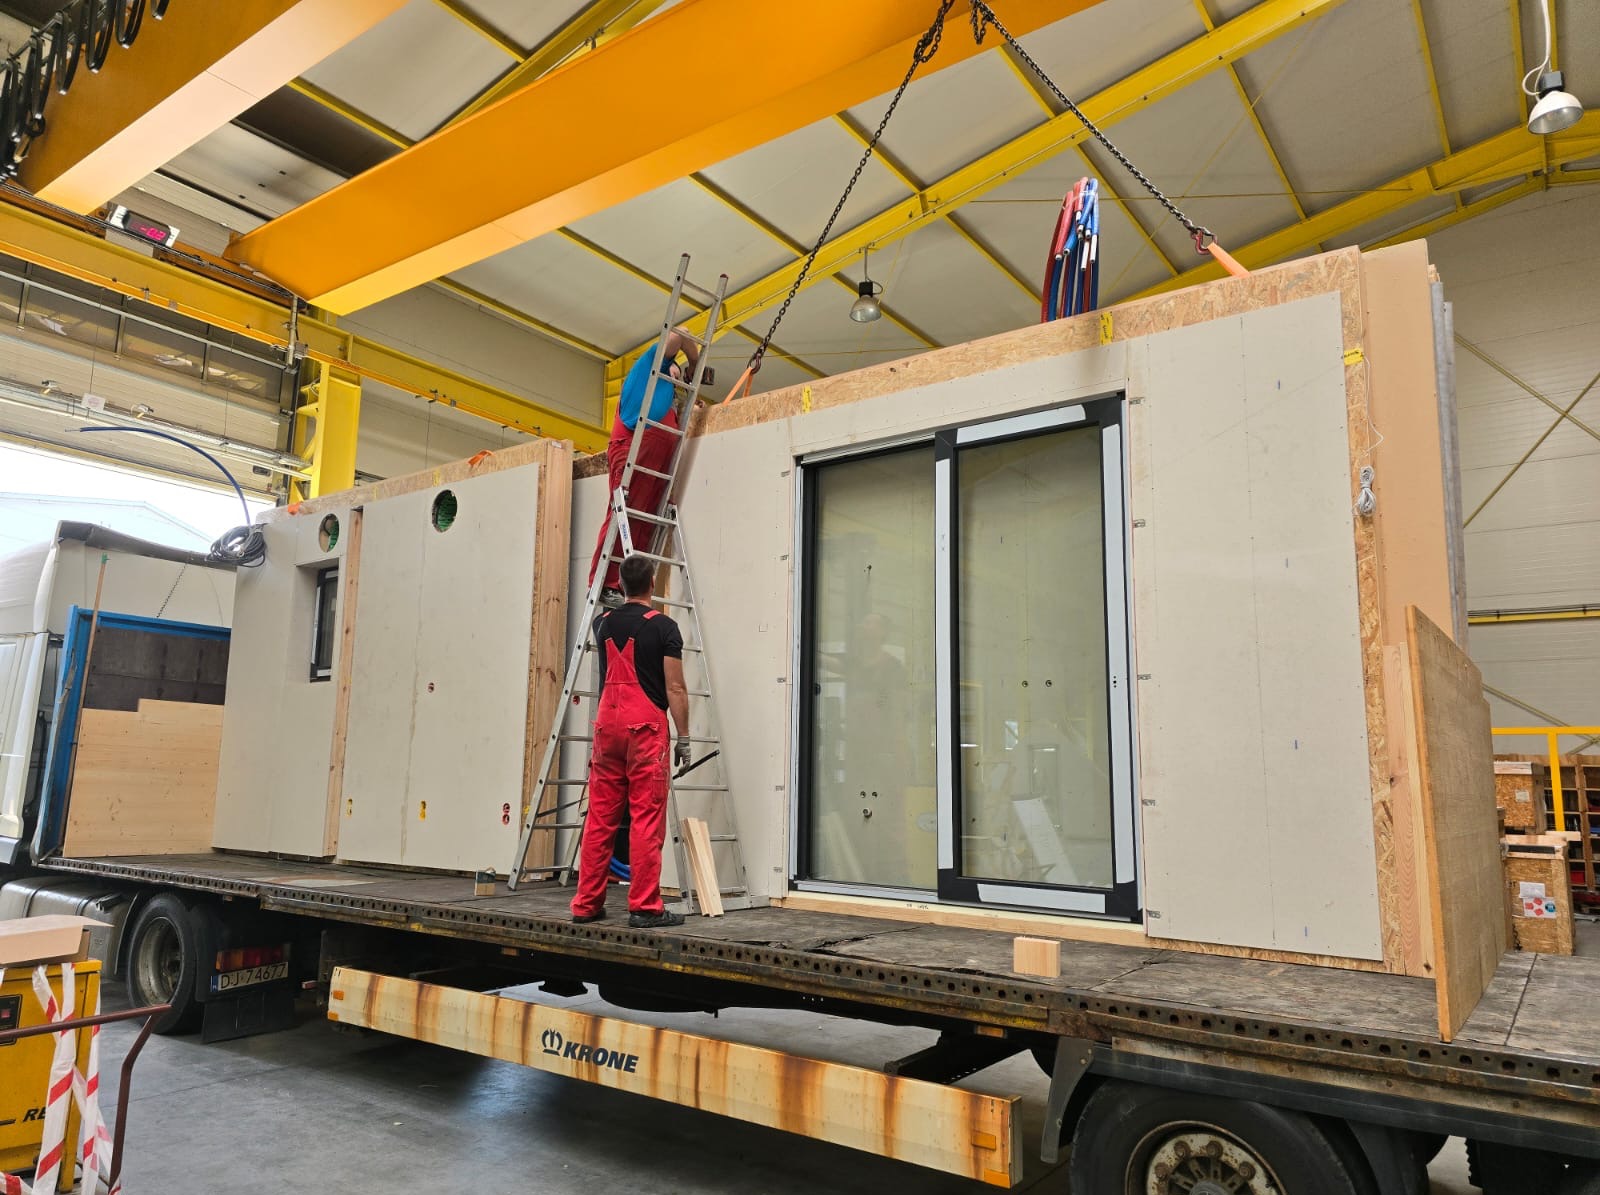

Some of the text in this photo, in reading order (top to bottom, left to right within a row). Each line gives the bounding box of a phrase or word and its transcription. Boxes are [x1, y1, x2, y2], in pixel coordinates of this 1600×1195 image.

[221, 964, 286, 989] DJ 74677
[563, 1041, 639, 1073] KRONE
